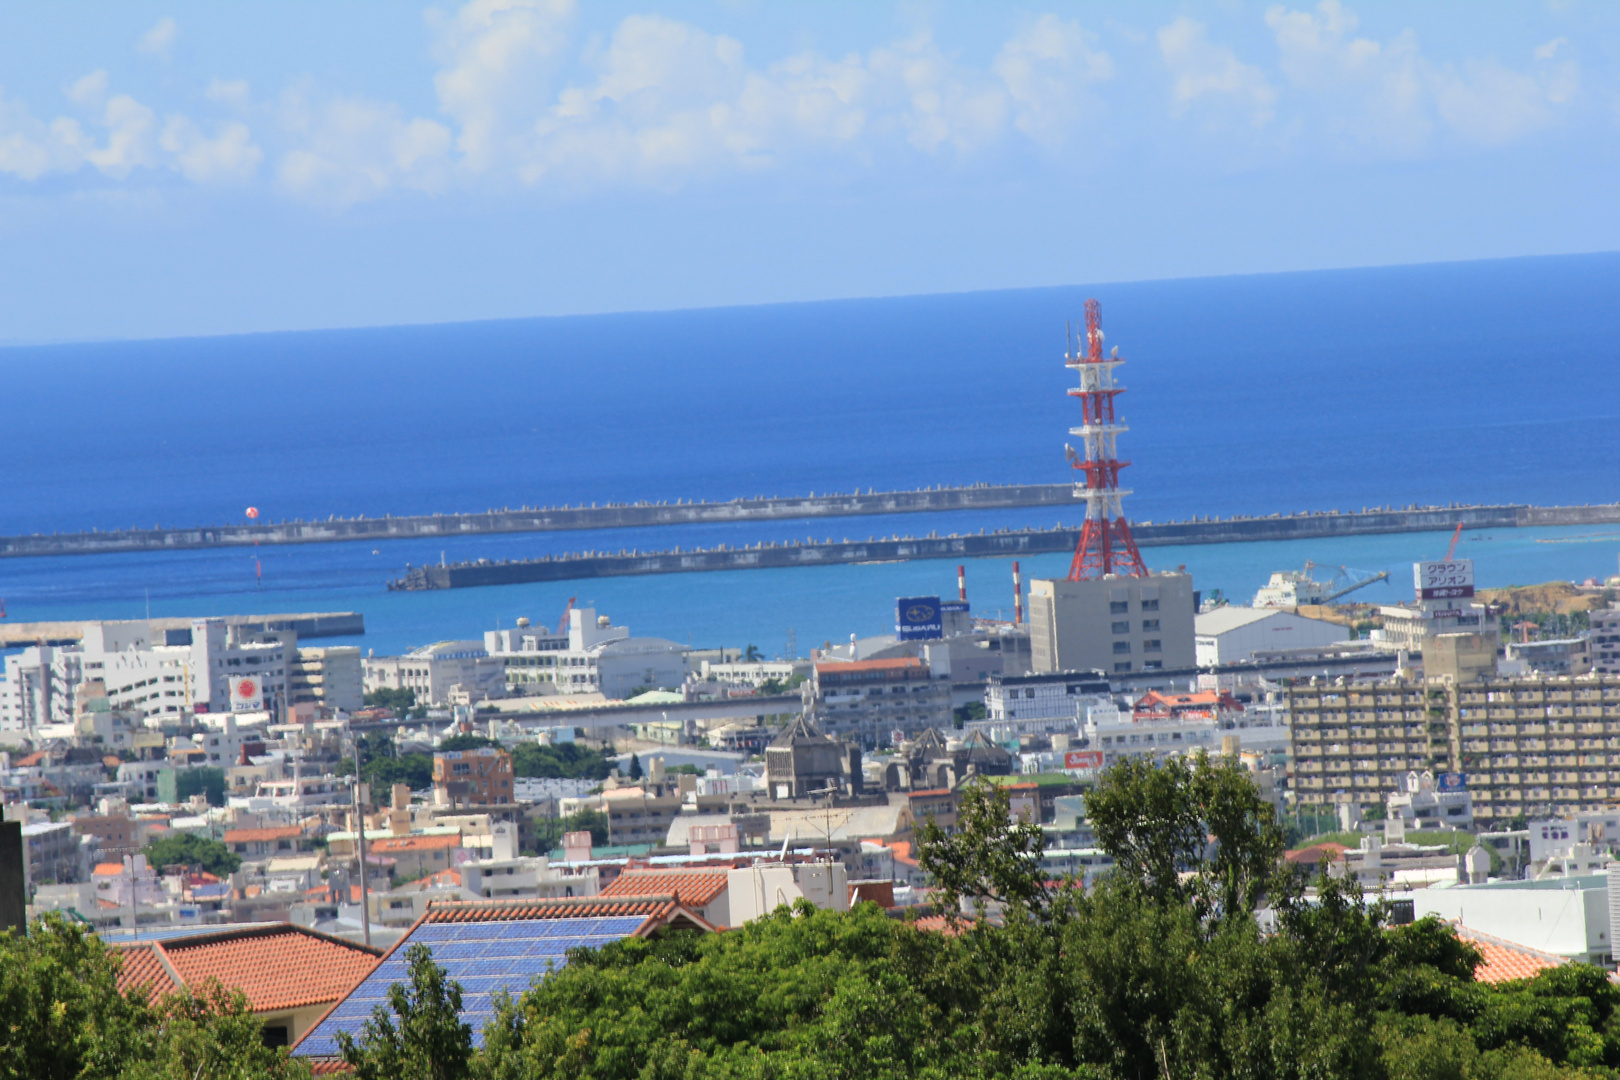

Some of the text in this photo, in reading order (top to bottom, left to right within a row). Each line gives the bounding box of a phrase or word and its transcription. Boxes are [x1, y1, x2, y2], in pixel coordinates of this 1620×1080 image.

[1427, 563, 1466, 574] クラウン
[1428, 575, 1466, 586] アリオン
[902, 624, 941, 632] SUBARU
